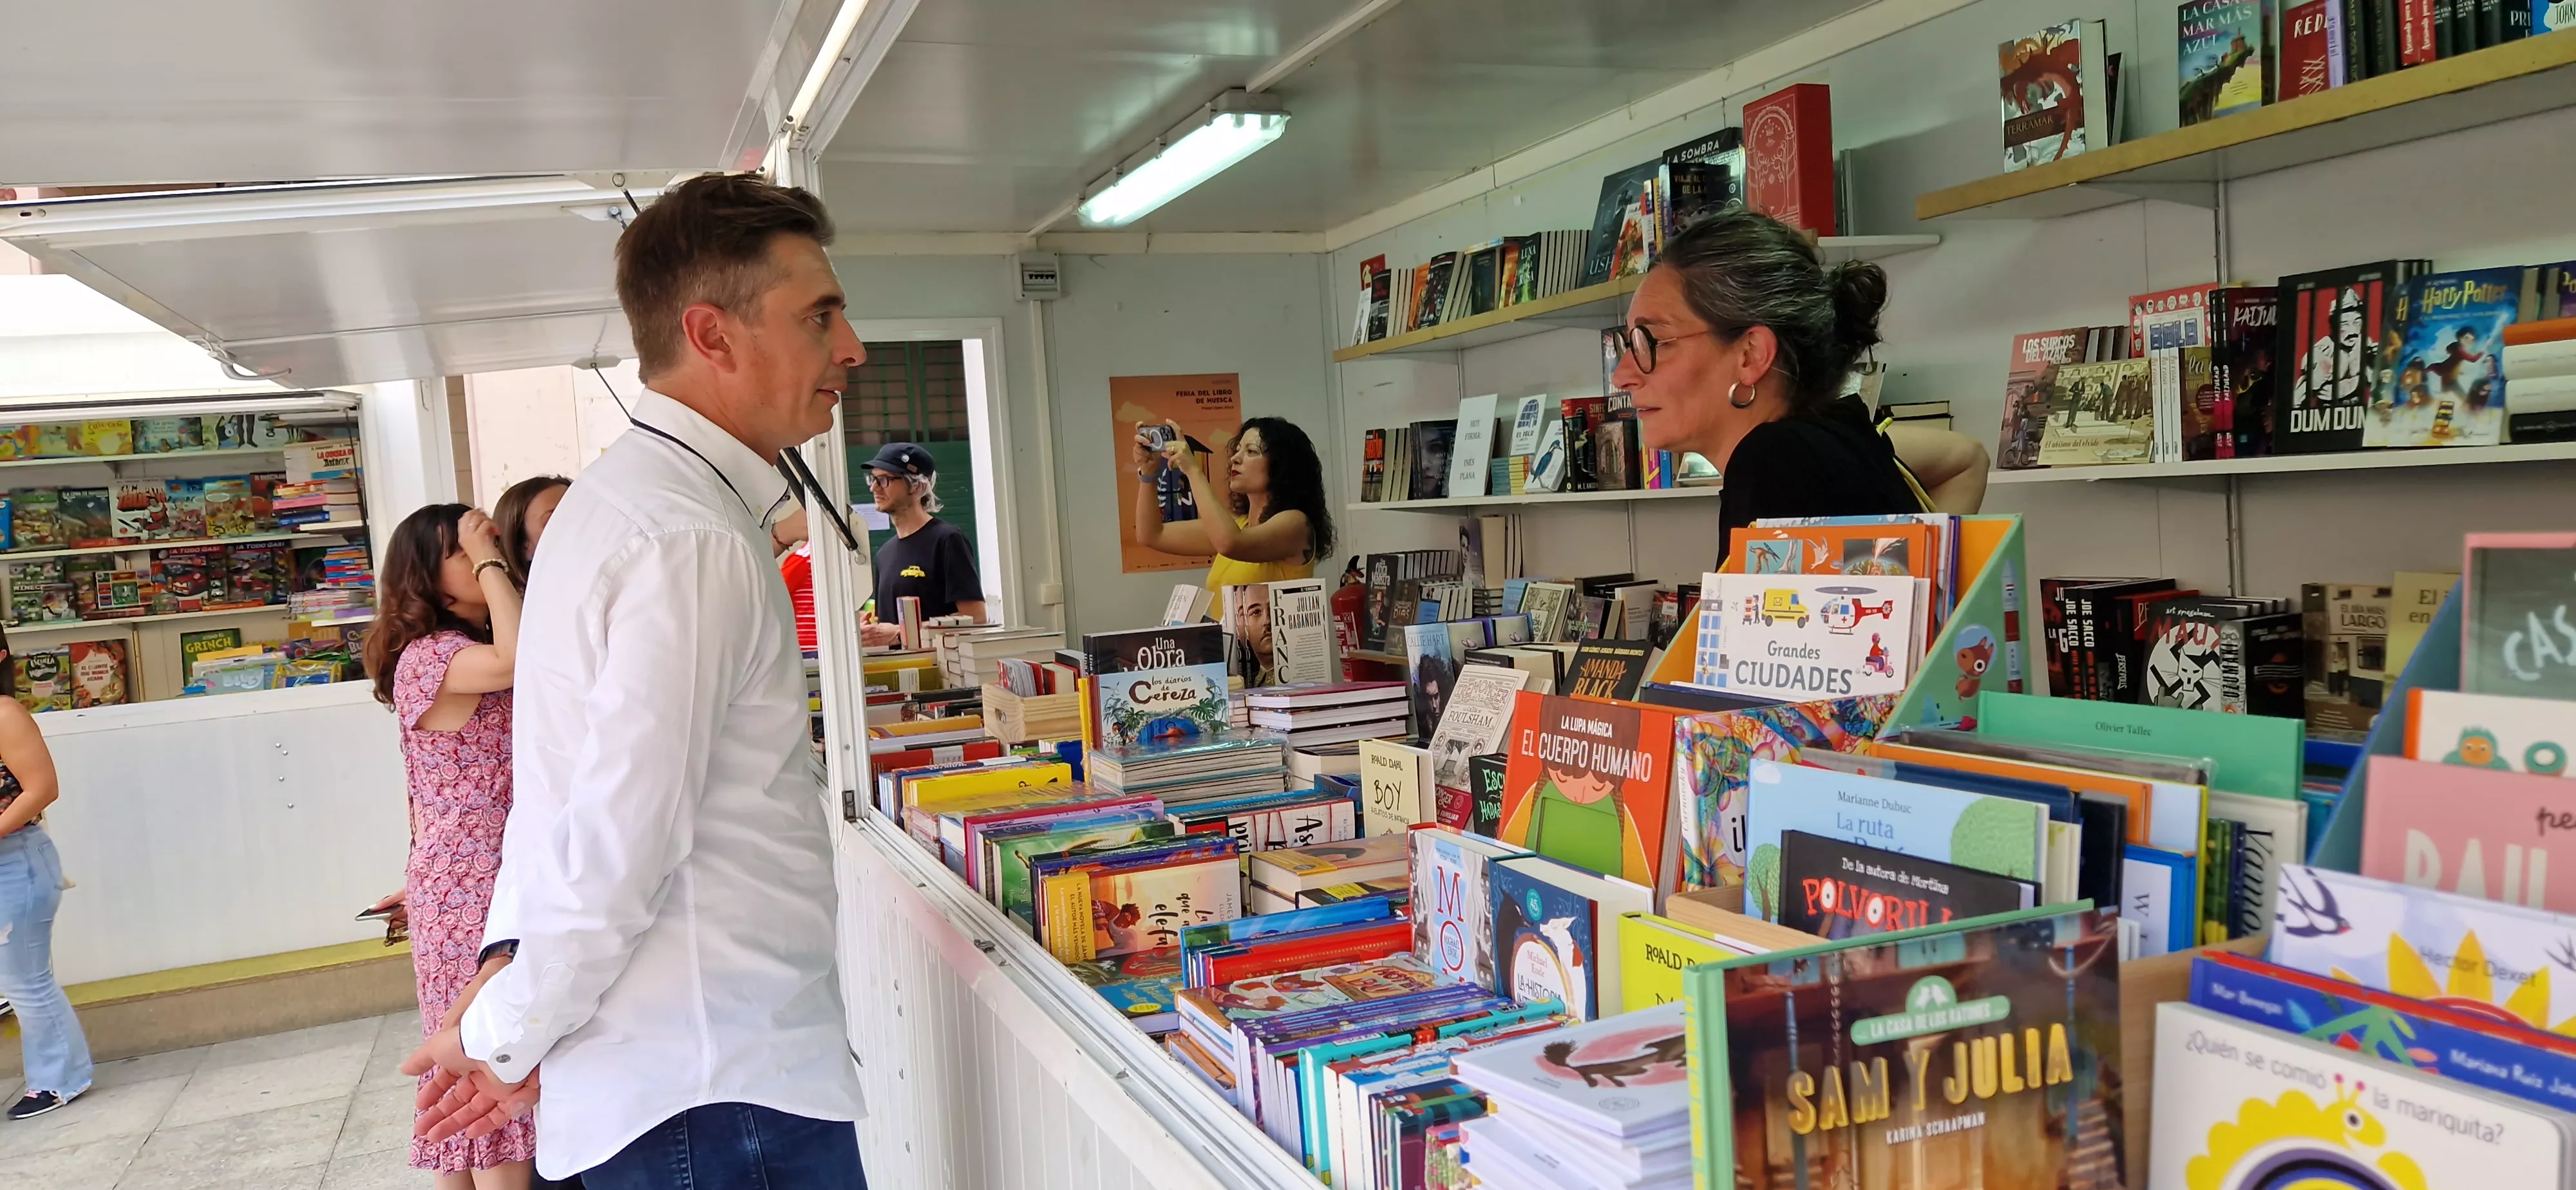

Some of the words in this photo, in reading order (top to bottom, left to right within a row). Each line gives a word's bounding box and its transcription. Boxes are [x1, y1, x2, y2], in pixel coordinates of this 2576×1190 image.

[2183, 8, 2199, 22] LA
[2183, 17, 2215, 38] MAR
[2219, 6, 2253, 26] MÁS
[2005, 114, 2055, 137] TERRAMAR
[1681, 140, 1719, 160] SOMBRA
[1682, 185, 1690, 194] DE
[1521, 245, 1536, 259] LUNA
[2421, 286, 2463, 314] Harry
[2463, 280, 2508, 308] Potter
[2022, 339, 2039, 354] LOS
[2041, 334, 2076, 351] SURCOS
[2025, 349, 2041, 363] DEL
[2042, 345, 2067, 361] AZAR
[2290, 408, 2330, 433] DUM
[1464, 458, 1475, 467] INÉS
[1459, 472, 1475, 480] PLANA
[1376, 562, 1387, 576] Obra
[1371, 571, 1390, 588] Maestra
[1296, 594, 1320, 611] JULIÁN
[2418, 589, 2437, 605] El
[2066, 599, 2076, 615] JOE
[2081, 599, 2092, 616] JOE
[2177, 609, 2215, 618] spiegelman
[1288, 611, 1321, 629] CASANOVA
[2342, 614, 2386, 628] LARGO
[1406, 635, 1426, 647] CALLIE
[1427, 634, 1445, 646] HART
[2048, 628, 2056, 639] LA
[2067, 619, 2079, 646] SACCO
[2083, 619, 2094, 647] SACCO
[185, 638, 232, 653] GRINCH
[1155, 637, 1175, 650] Una
[1766, 640, 1821, 661] Grandes
[1137, 645, 1186, 670] Obra
[1580, 658, 1627, 680] AMANDA
[1734, 659, 1853, 696] CIUDADES
[2222, 643, 2240, 698] UZUMAKI
[1151, 676, 1162, 686] los
[1165, 675, 1192, 685] diarios
[1573, 678, 1620, 699] BLACK
[1128, 681, 1197, 705] Cereza
[1447, 710, 1493, 728] FOULSHAM
[1561, 715, 1569, 730] LA
[1571, 717, 1587, 733] LUPA
[1587, 717, 1613, 738] MÁGICA
[2095, 721, 2125, 733] Olivier
[2126, 724, 2152, 737] Tallec
[1371, 755, 1387, 767] ROALD
[1388, 759, 1403, 771] DAHL
[1521, 728, 1534, 757] EL
[1538, 732, 1588, 768] CUERPO
[1591, 746, 1653, 782] HUMANO
[1373, 779, 1401, 811] BOY
[1678, 766, 1689, 832] Carnovsky
[1837, 790, 1880, 809] Marianne
[1881, 798, 1912, 815] Dubuc
[1370, 806, 1388, 819] RELATOS
[1837, 811, 1854, 832] La
[1857, 817, 1895, 840] ruta
[1842, 857, 1855, 871] De
[1855, 860, 1865, 873] la
[1866, 864, 1897, 882] autora
[1897, 871, 1909, 885] de
[1176, 893, 1191, 914] que
[1195, 911, 1214, 922] La
[1444, 934, 1460, 950] MICHAEL
[1447, 946, 1457, 958] ENDE
[1527, 950, 1548, 968] Michael
[1645, 943, 1682, 970] ROALD
[1531, 963, 1544, 978] Ende
[2420, 945, 2477, 973] Hector
[2484, 959, 2537, 988] Dexet
[1518, 973, 1525, 992] LA
[1870, 1023, 1886, 1039] LA
[1886, 1017, 1913, 1035] CASA
[1914, 1015, 1928, 1032] DE
[1927, 1012, 1949, 1030] LOS
[1949, 1003, 1991, 1026] RATONES
[1786, 1057, 1891, 1135] SAM
[1904, 1046, 1931, 1113] Y
[1942, 1023, 2074, 1106] JULIA
[2449, 1049, 2510, 1079] Mariana
[2512, 1064, 2544, 1090] Ruiz
[2184, 1030, 2239, 1059] ¿Quién
[2244, 1050, 2267, 1068] se
[2270, 1053, 2327, 1091] comió
[2372, 1086, 2391, 1110] la
[2396, 1092, 2505, 1146] mariquita?
[1885, 1123, 1924, 1146] KARINA
[1926, 1111, 1986, 1137] SCHAAPMAN
